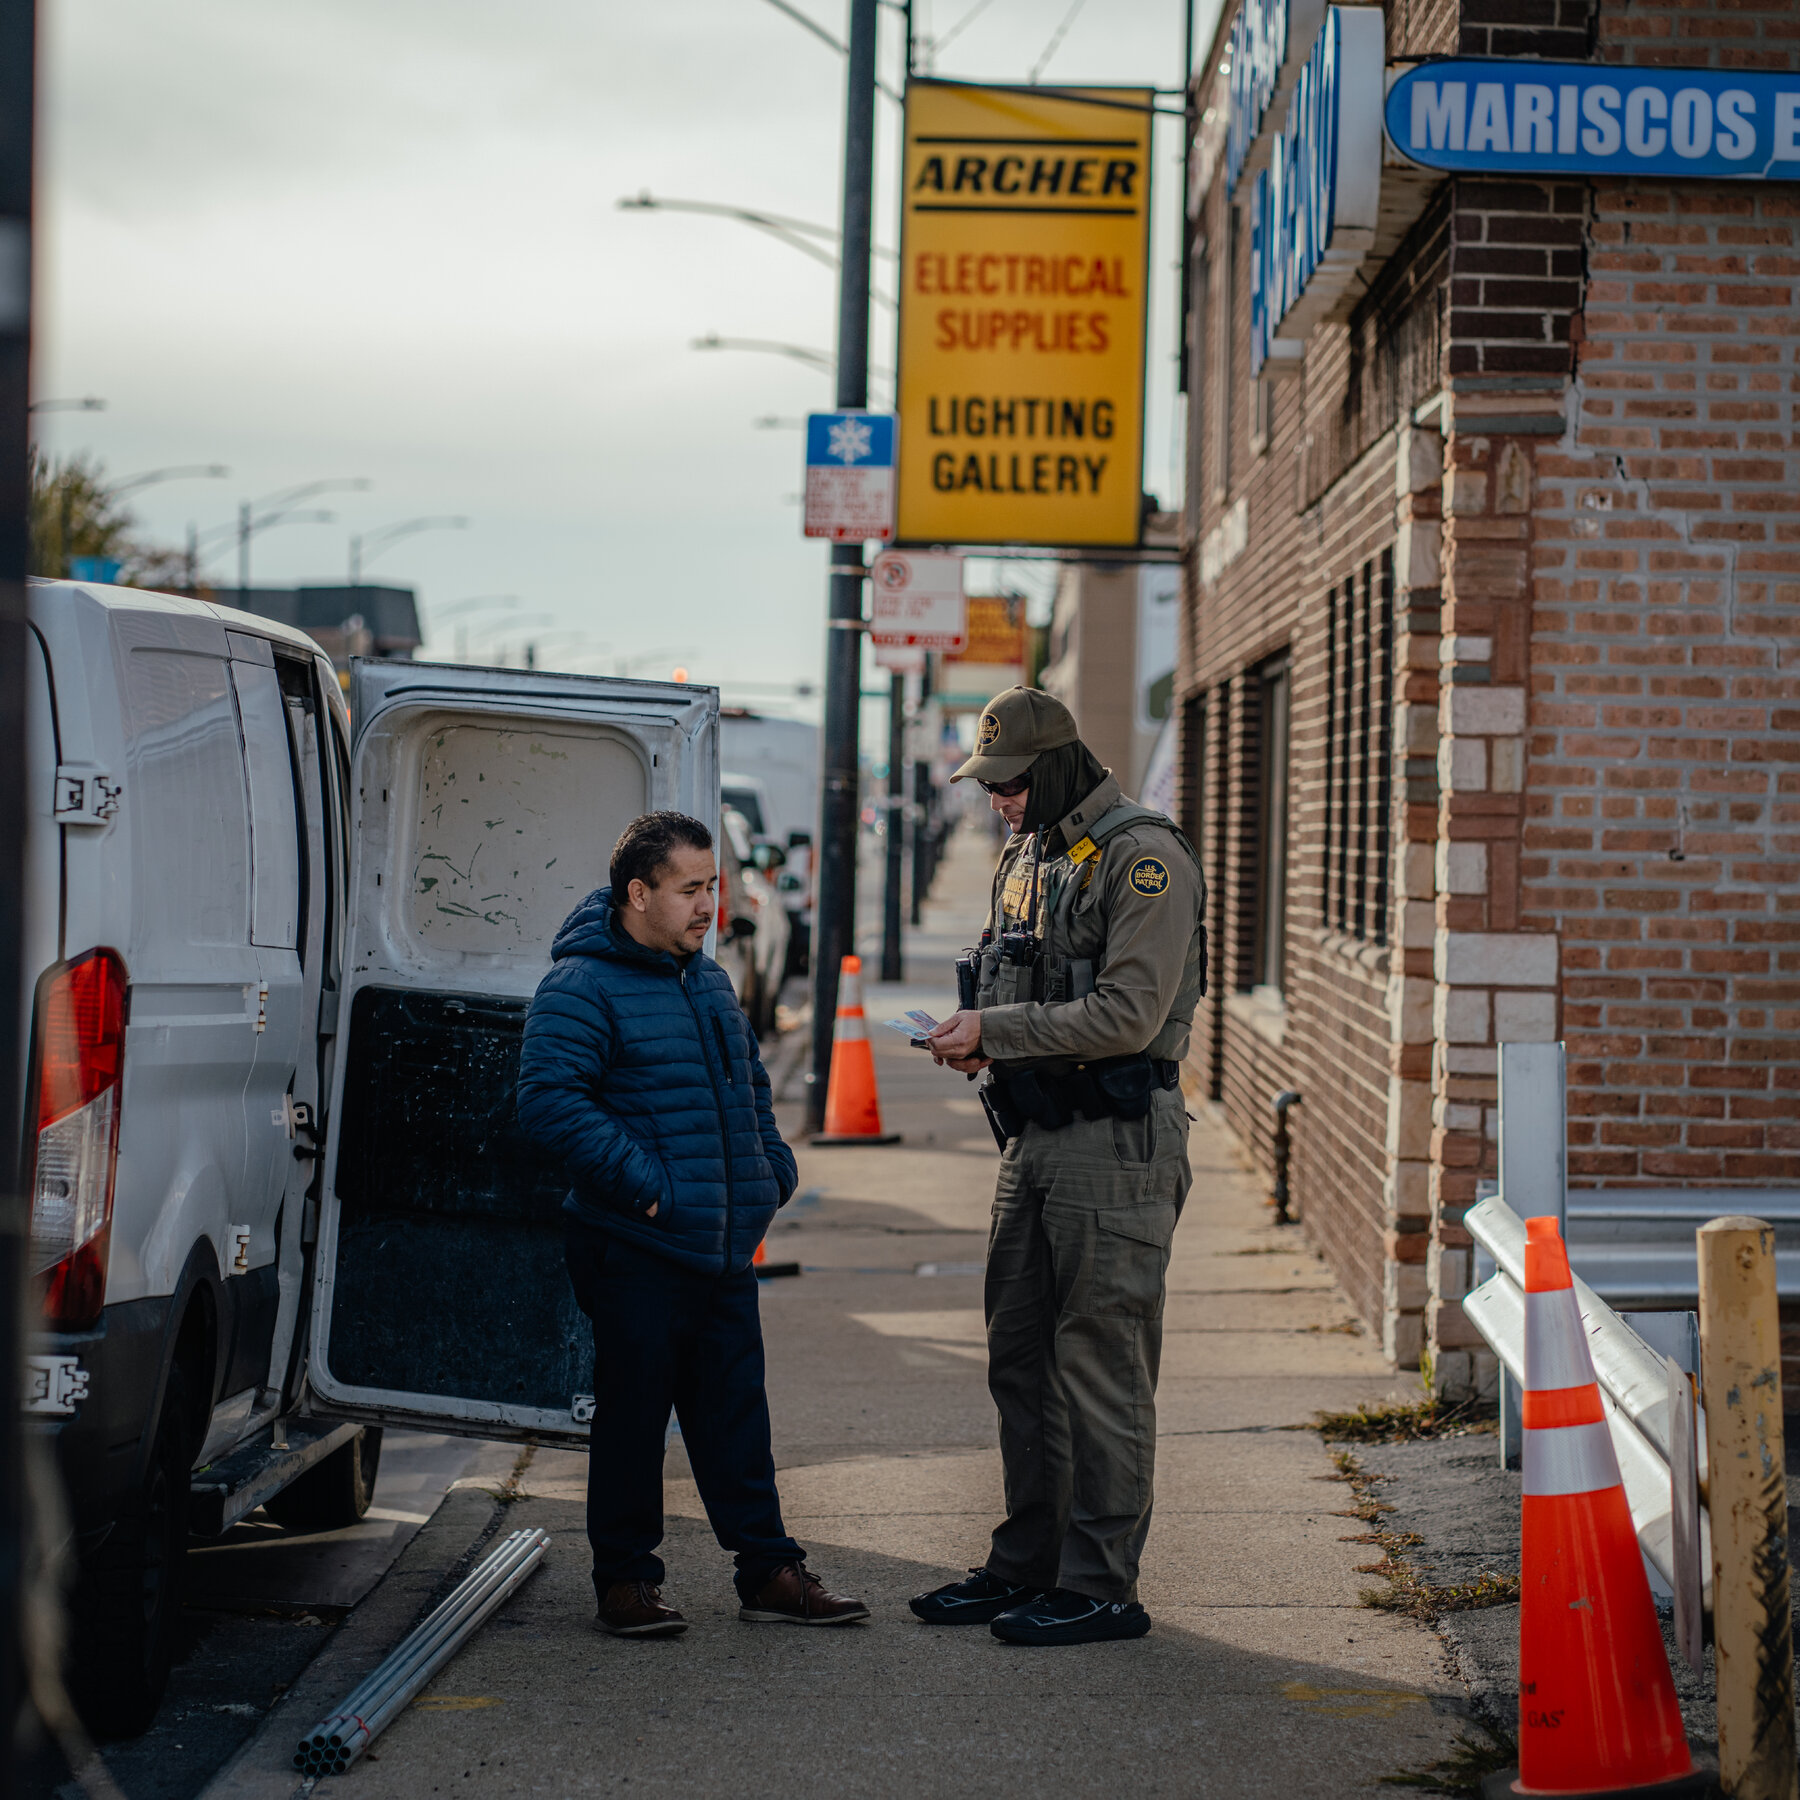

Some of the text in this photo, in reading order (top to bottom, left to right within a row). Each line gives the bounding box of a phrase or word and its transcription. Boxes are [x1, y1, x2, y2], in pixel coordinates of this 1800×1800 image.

[1410, 81, 1757, 160] MARISCOS
[914, 155, 1138, 196] ARCHER
[914, 251, 1132, 299] ELECTRICAL
[936, 307, 1110, 353] SUPPLIES
[928, 395, 1115, 440] LIGHTING
[932, 451, 1109, 493] GALLERY
[1135, 878, 1162, 888] PATROL
[1136, 871, 1164, 881] BORDER
